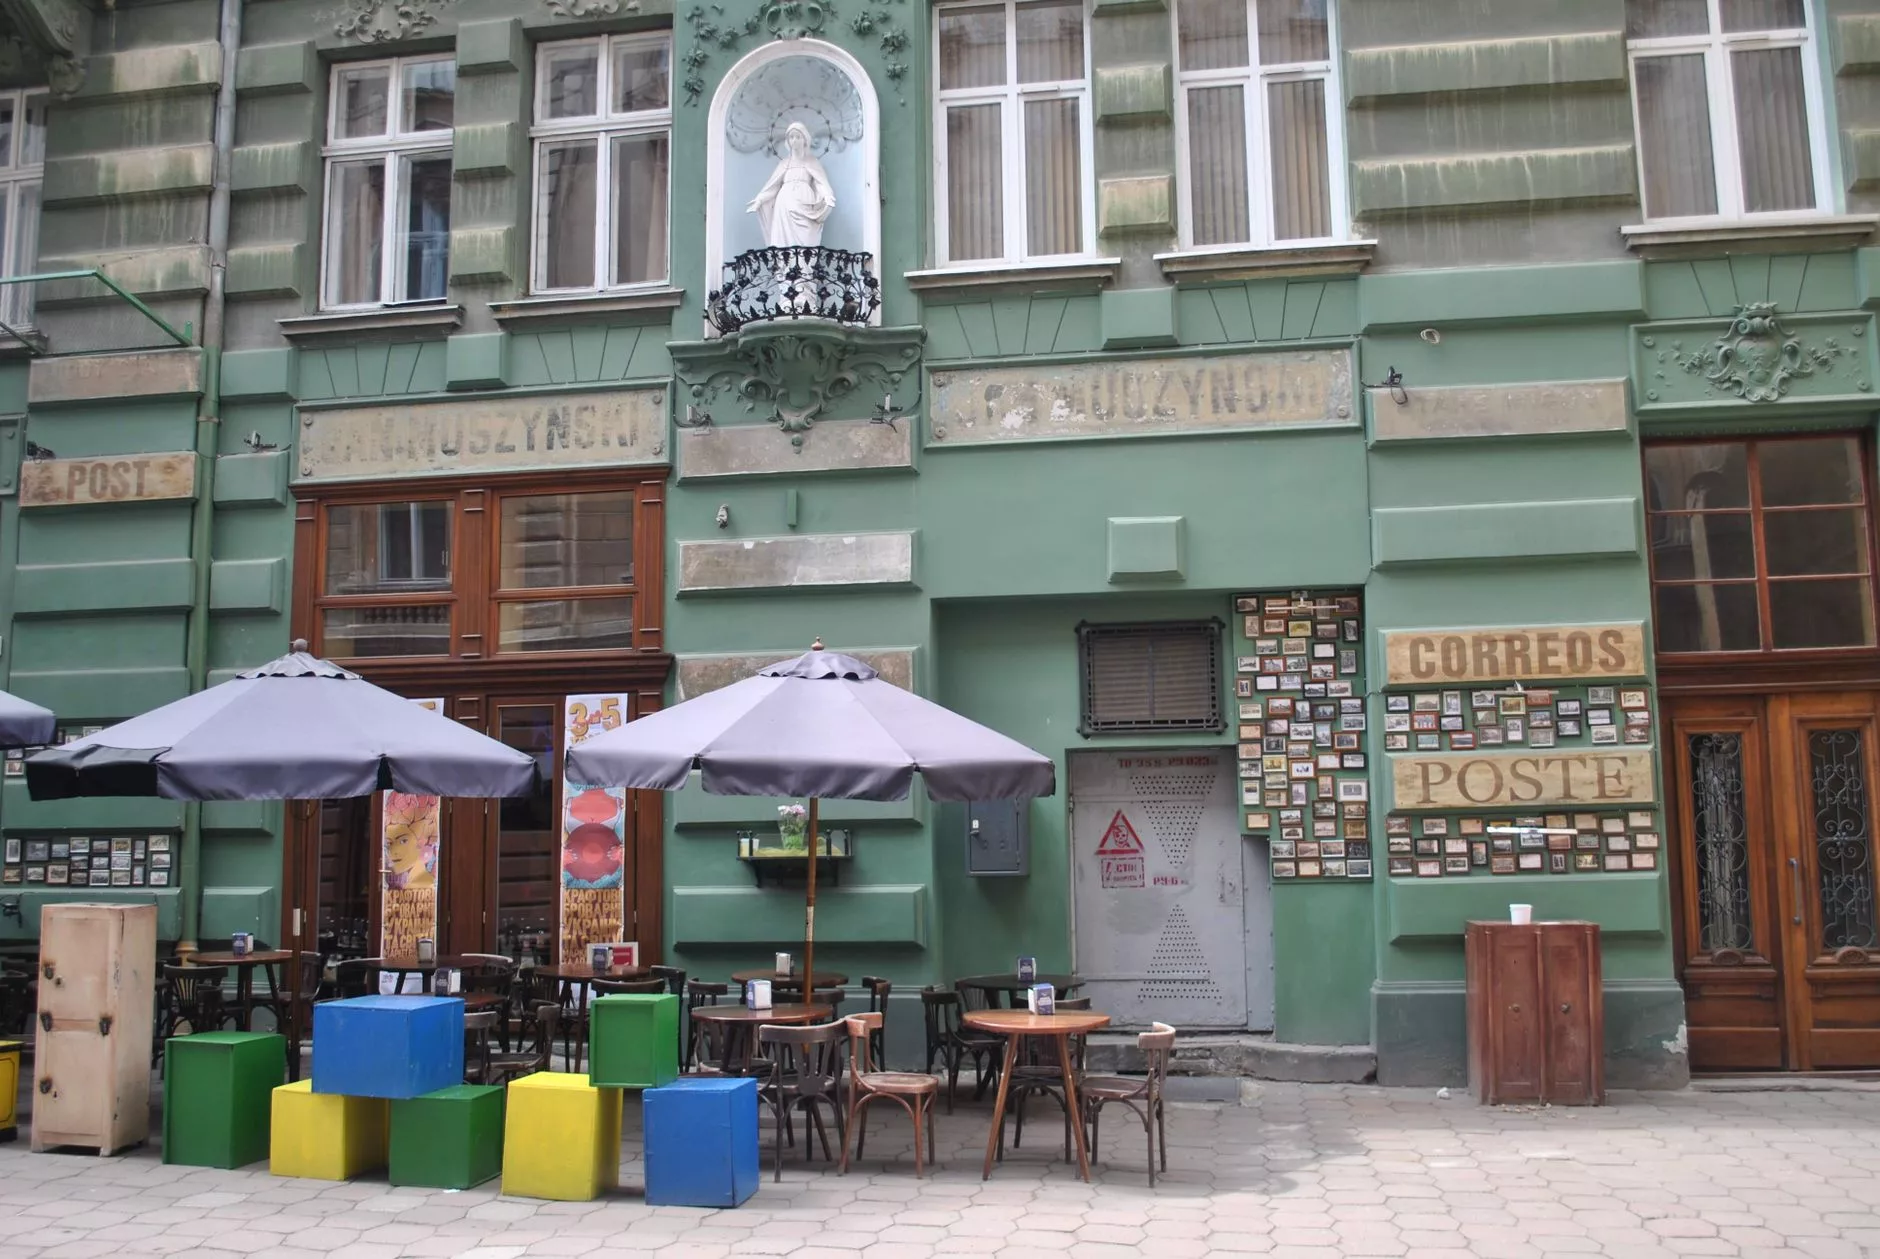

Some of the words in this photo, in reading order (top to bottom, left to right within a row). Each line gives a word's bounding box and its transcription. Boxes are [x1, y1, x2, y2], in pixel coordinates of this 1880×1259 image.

[66, 460, 150, 501] POST
[1408, 629, 1627, 679] CORREOS
[1415, 756, 1633, 804] POSTE
